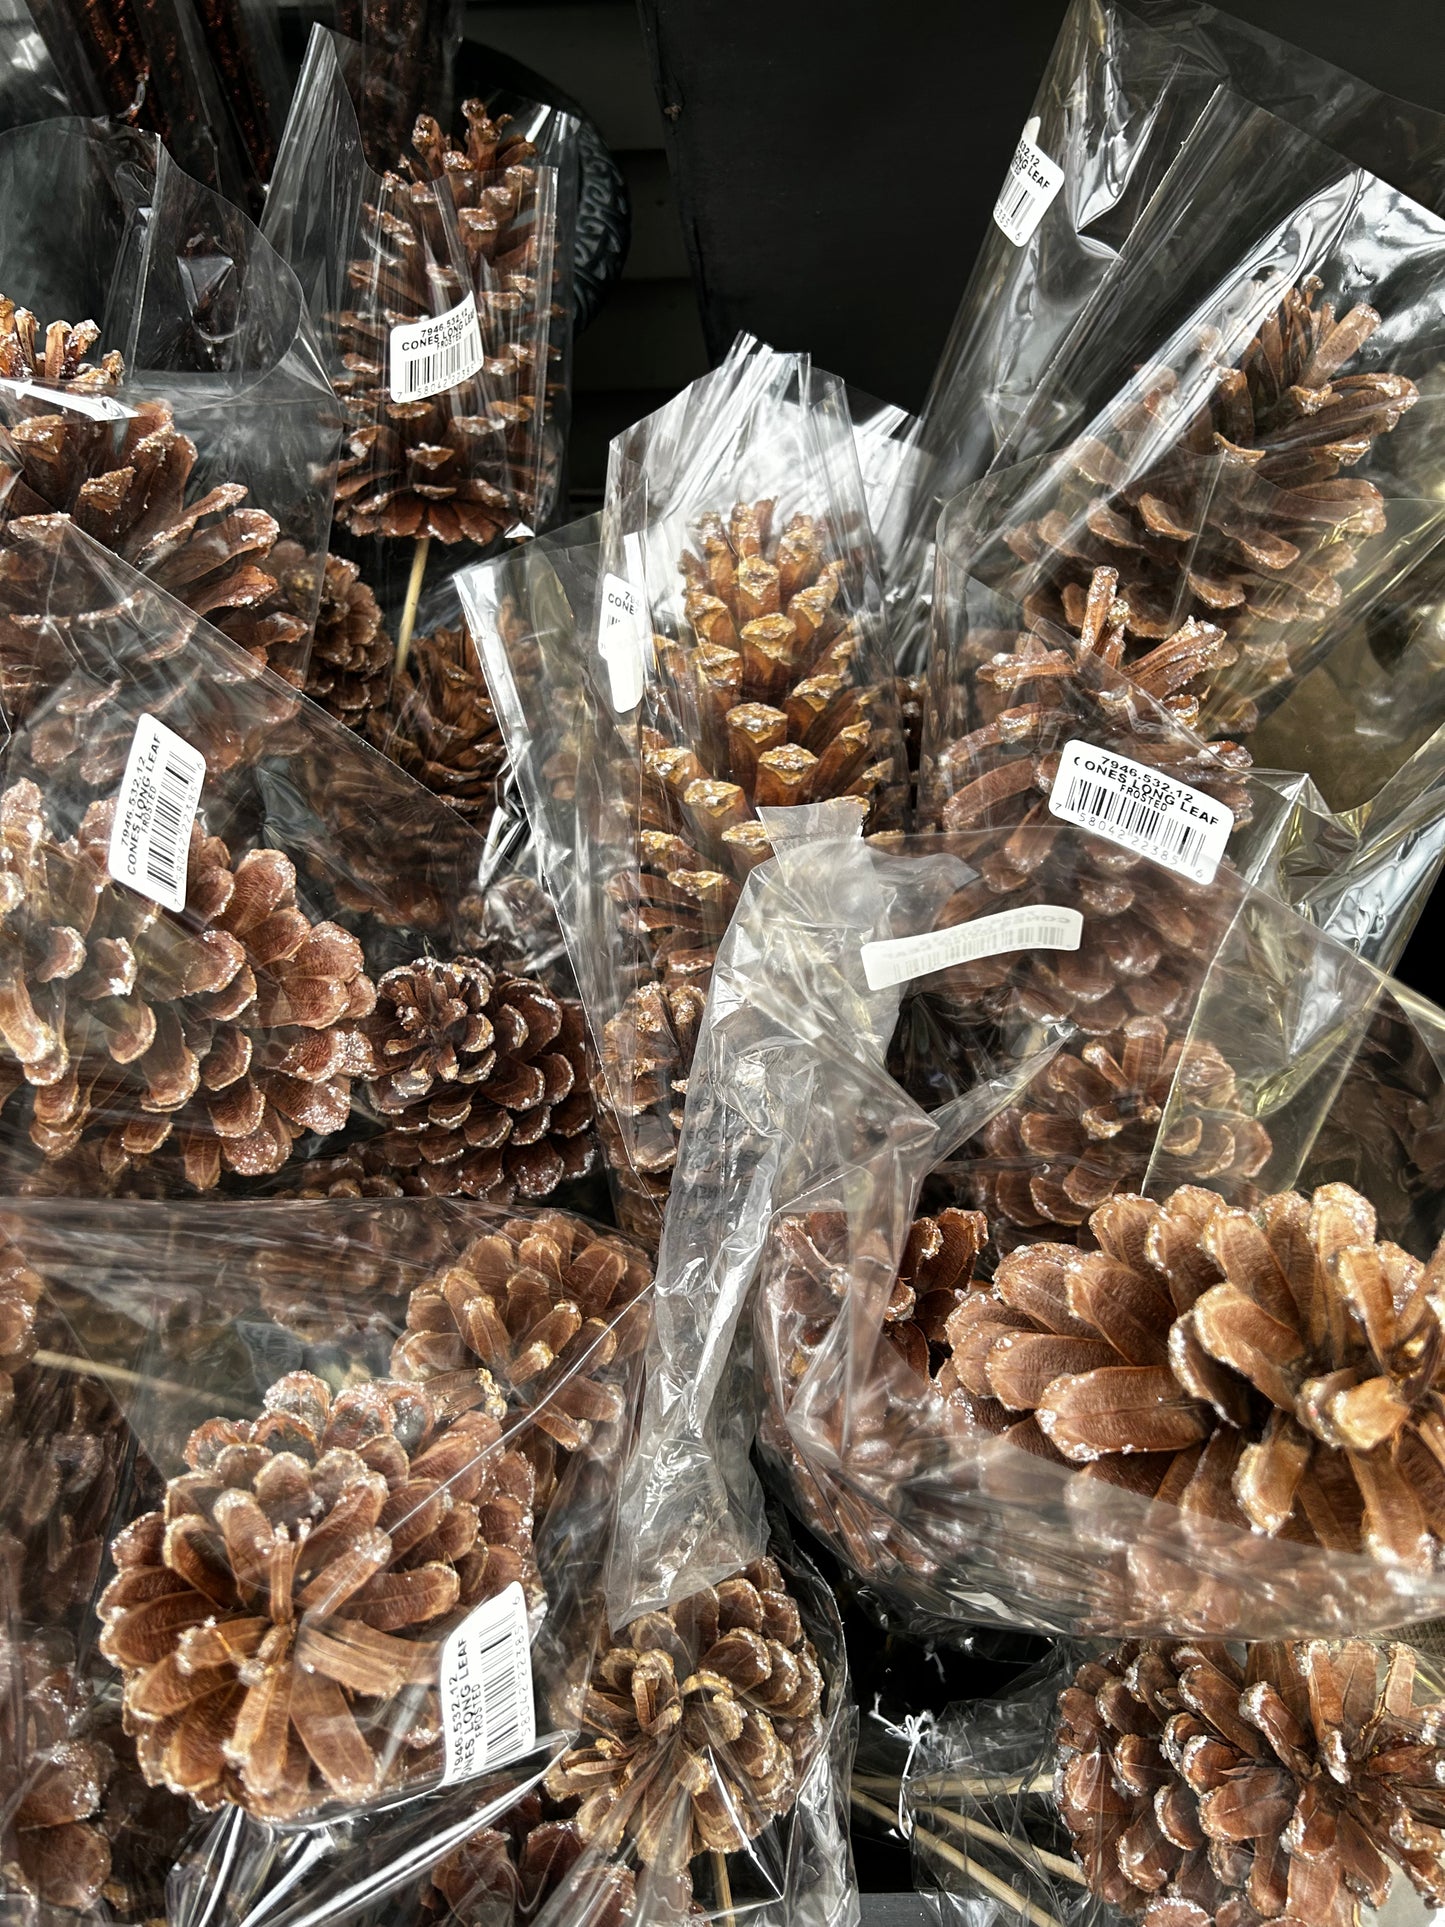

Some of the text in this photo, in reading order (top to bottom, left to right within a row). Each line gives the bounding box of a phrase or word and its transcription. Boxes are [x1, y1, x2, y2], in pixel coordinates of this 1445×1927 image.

[1027, 165, 1051, 190] LEAF
[401, 333, 440, 351] CONES
[442, 321, 464, 339] LONG
[421, 307, 468, 338] 7946.532.12
[607, 592, 637, 615] CONE
[121, 756, 146, 846] 7946.532.12
[127, 733, 162, 875] CONES LONG LEAF
[1073, 756, 1219, 826] CONES LONG LEAF
[1101, 756, 1194, 804] 7946.532.12
[1119, 784, 1168, 812] FROSTED
[141, 785, 157, 834] FROSTED
[175, 836, 189, 882] 58042
[183, 786, 199, 833] 22385
[1078, 812, 1126, 841] 58042
[1131, 836, 1179, 865] 22385
[457, 1638, 470, 1681] LEAF
[449, 1675, 465, 1775] 7946.532.12
[460, 1684, 476, 1736] LONG
[470, 1683, 484, 1739] FROSTED
